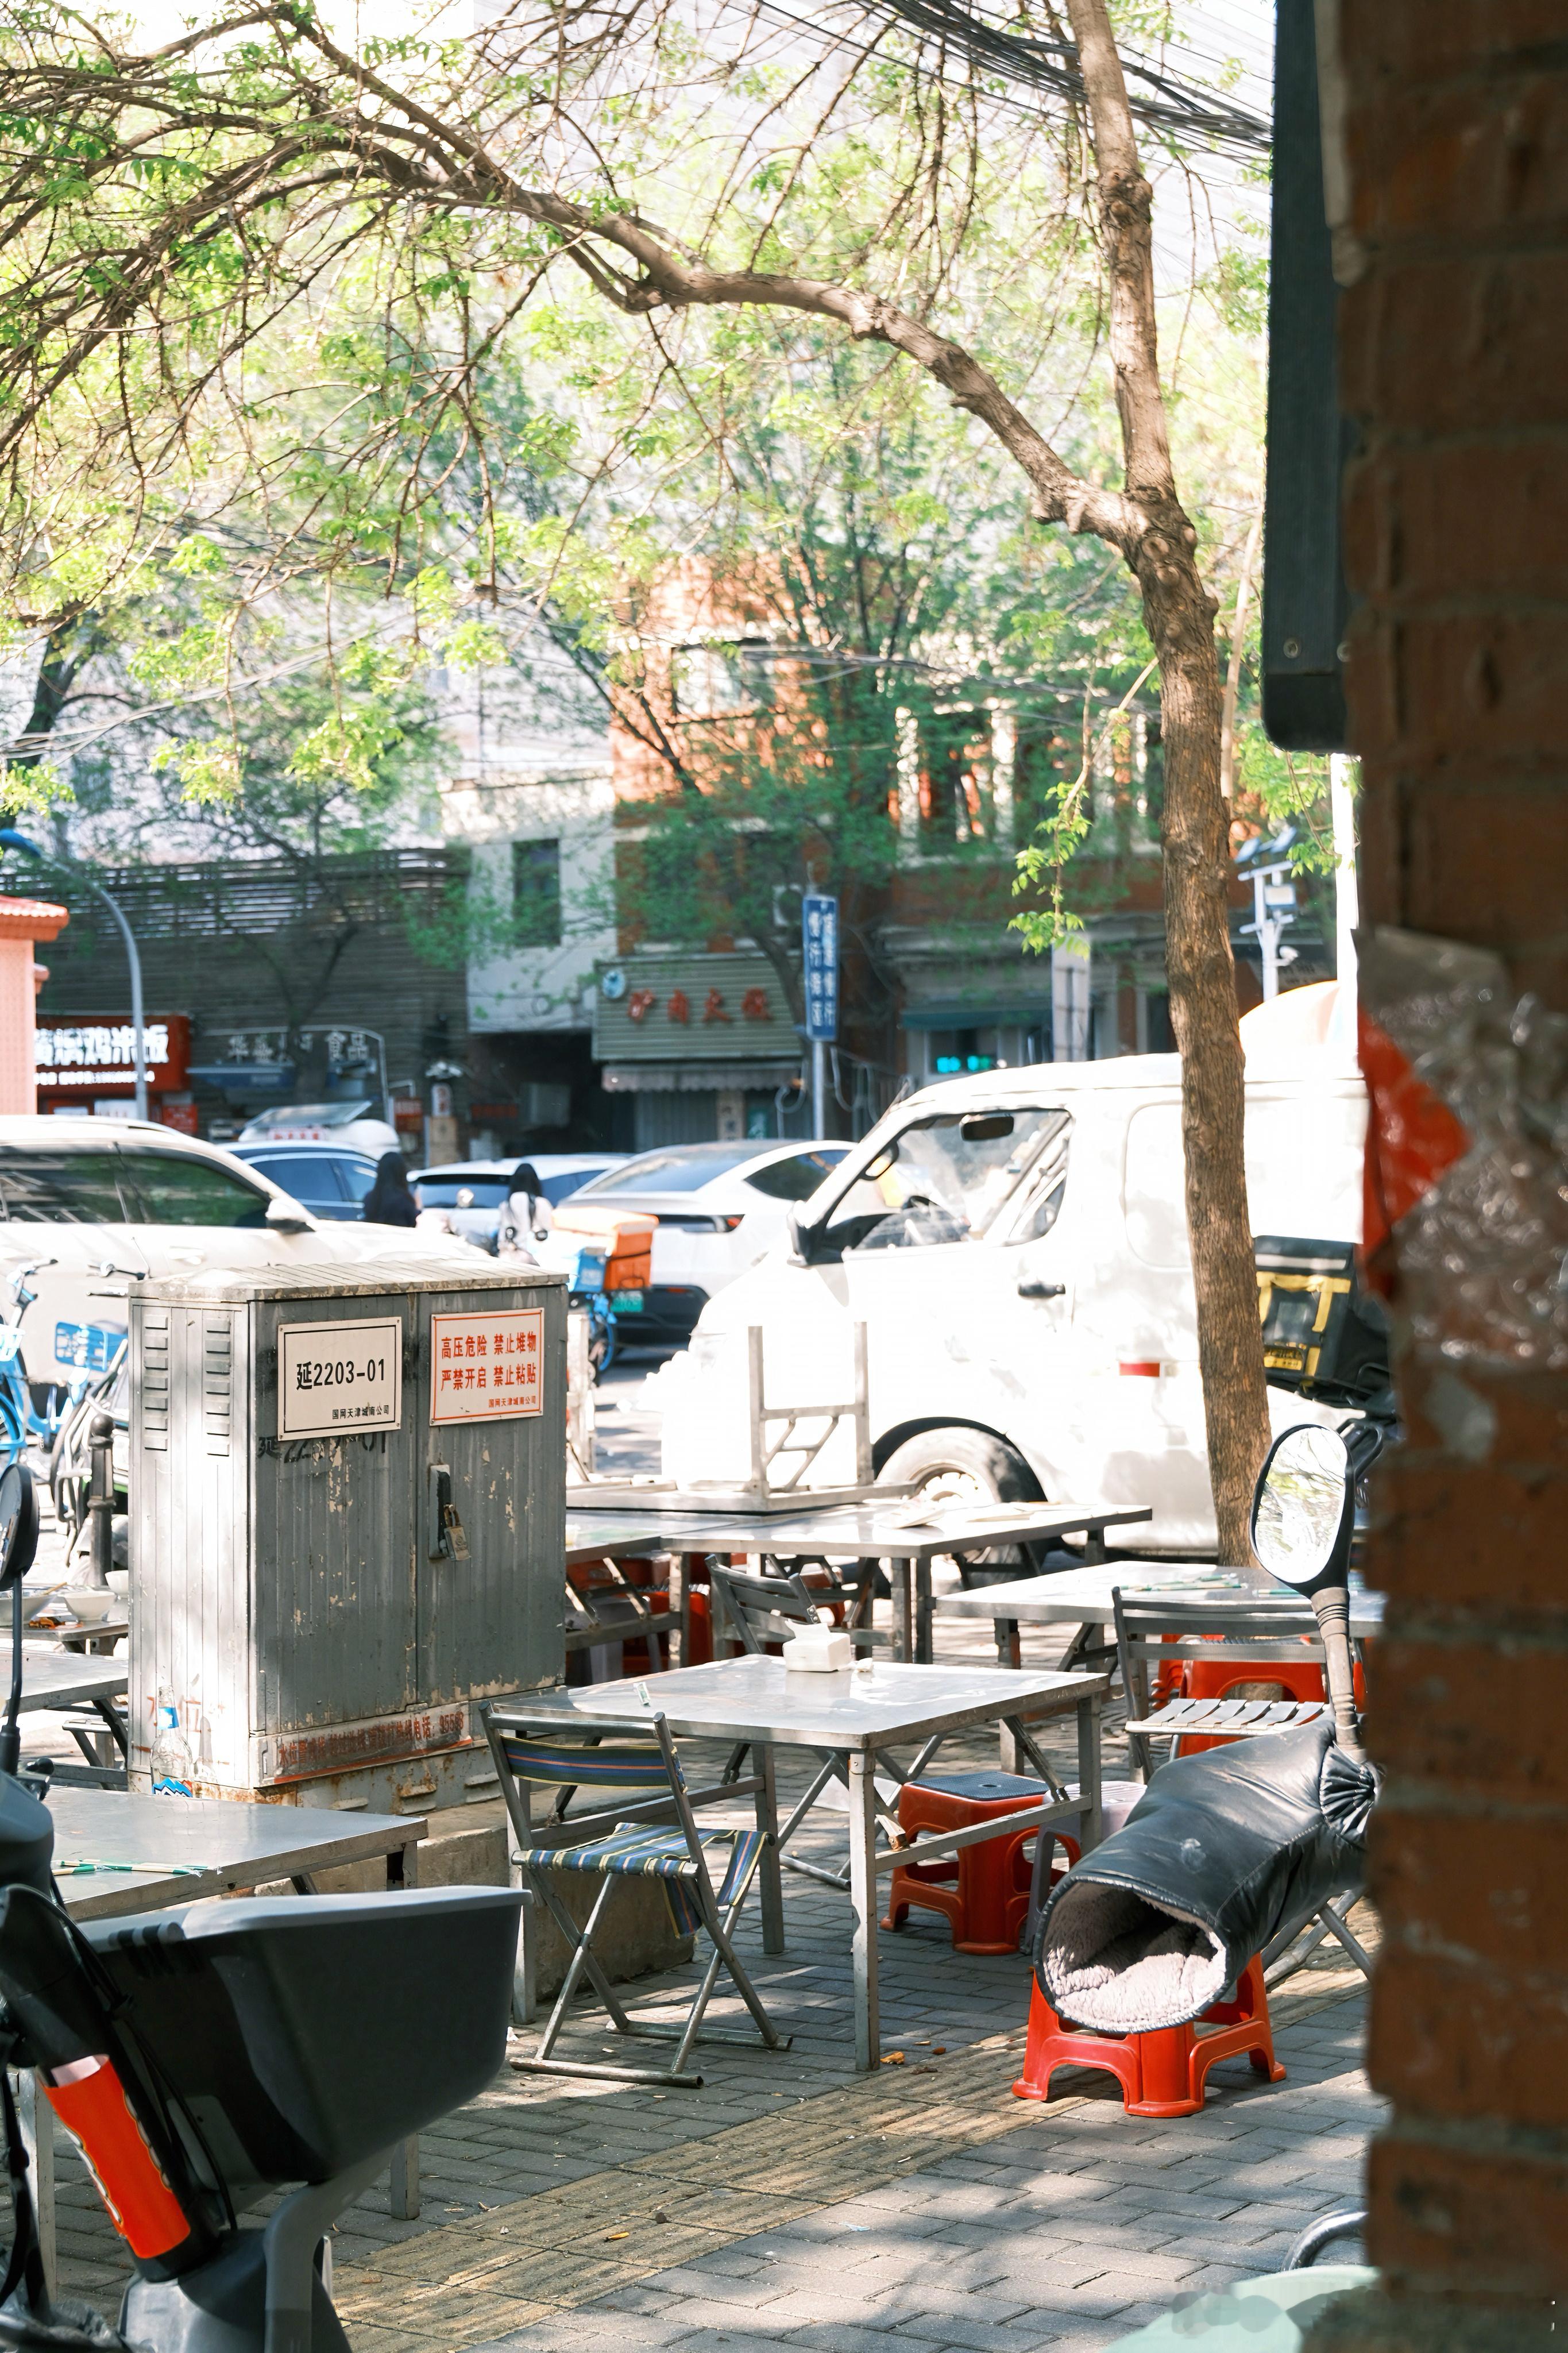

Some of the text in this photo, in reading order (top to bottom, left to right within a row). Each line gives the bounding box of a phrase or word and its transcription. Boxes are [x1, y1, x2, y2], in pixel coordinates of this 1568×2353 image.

[441, 1330, 536, 1359] 高压危险 禁止堆物
[296, 1359, 384, 1391] 延2203-01
[441, 1362, 536, 1391] 严禁开启 禁止粘贴
[332, 1405, 389, 1420] 国网天津城南公司
[489, 1395, 536, 1408] 国网天津城南公司
